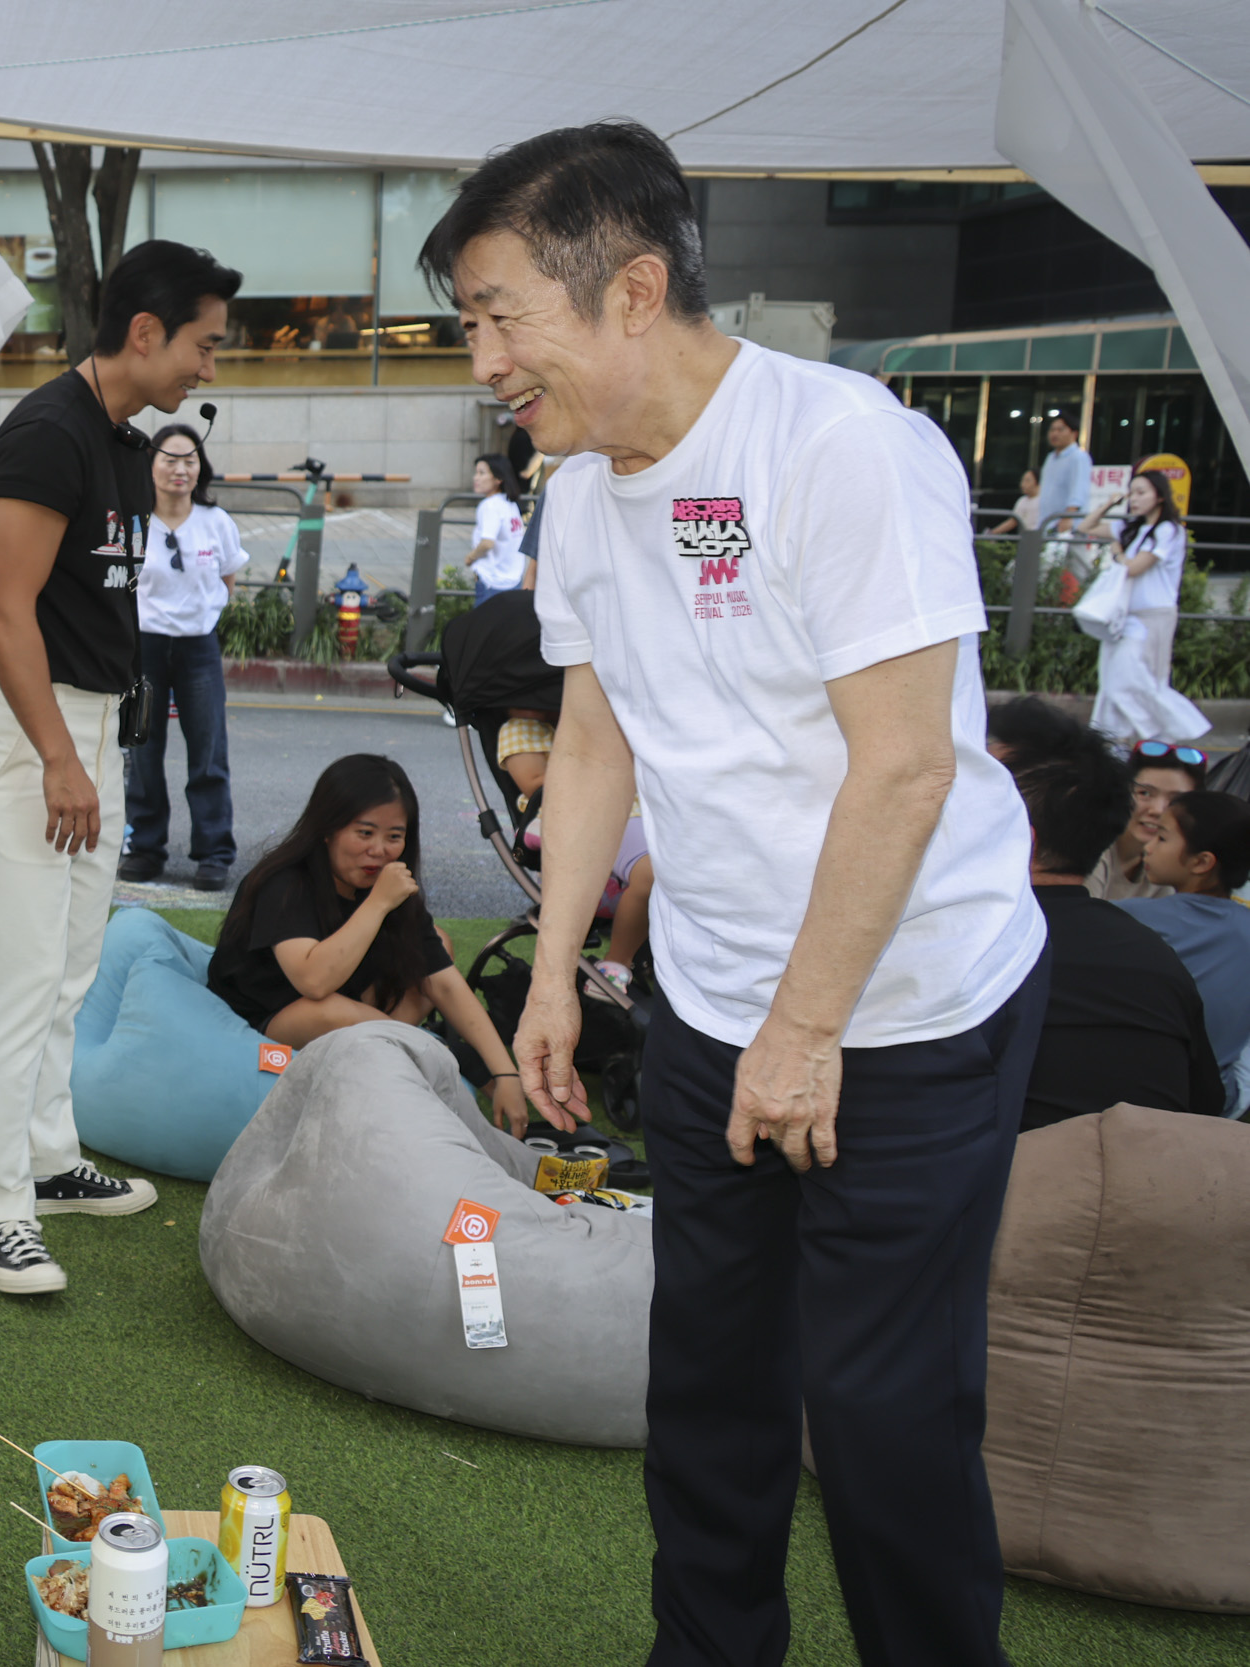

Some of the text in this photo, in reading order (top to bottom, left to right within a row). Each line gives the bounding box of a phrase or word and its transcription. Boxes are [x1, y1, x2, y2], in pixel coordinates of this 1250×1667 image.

[673, 520, 750, 556] 전성수
[321, 1630, 333, 1655] Truffle
[338, 1630, 351, 1657] Cracker
